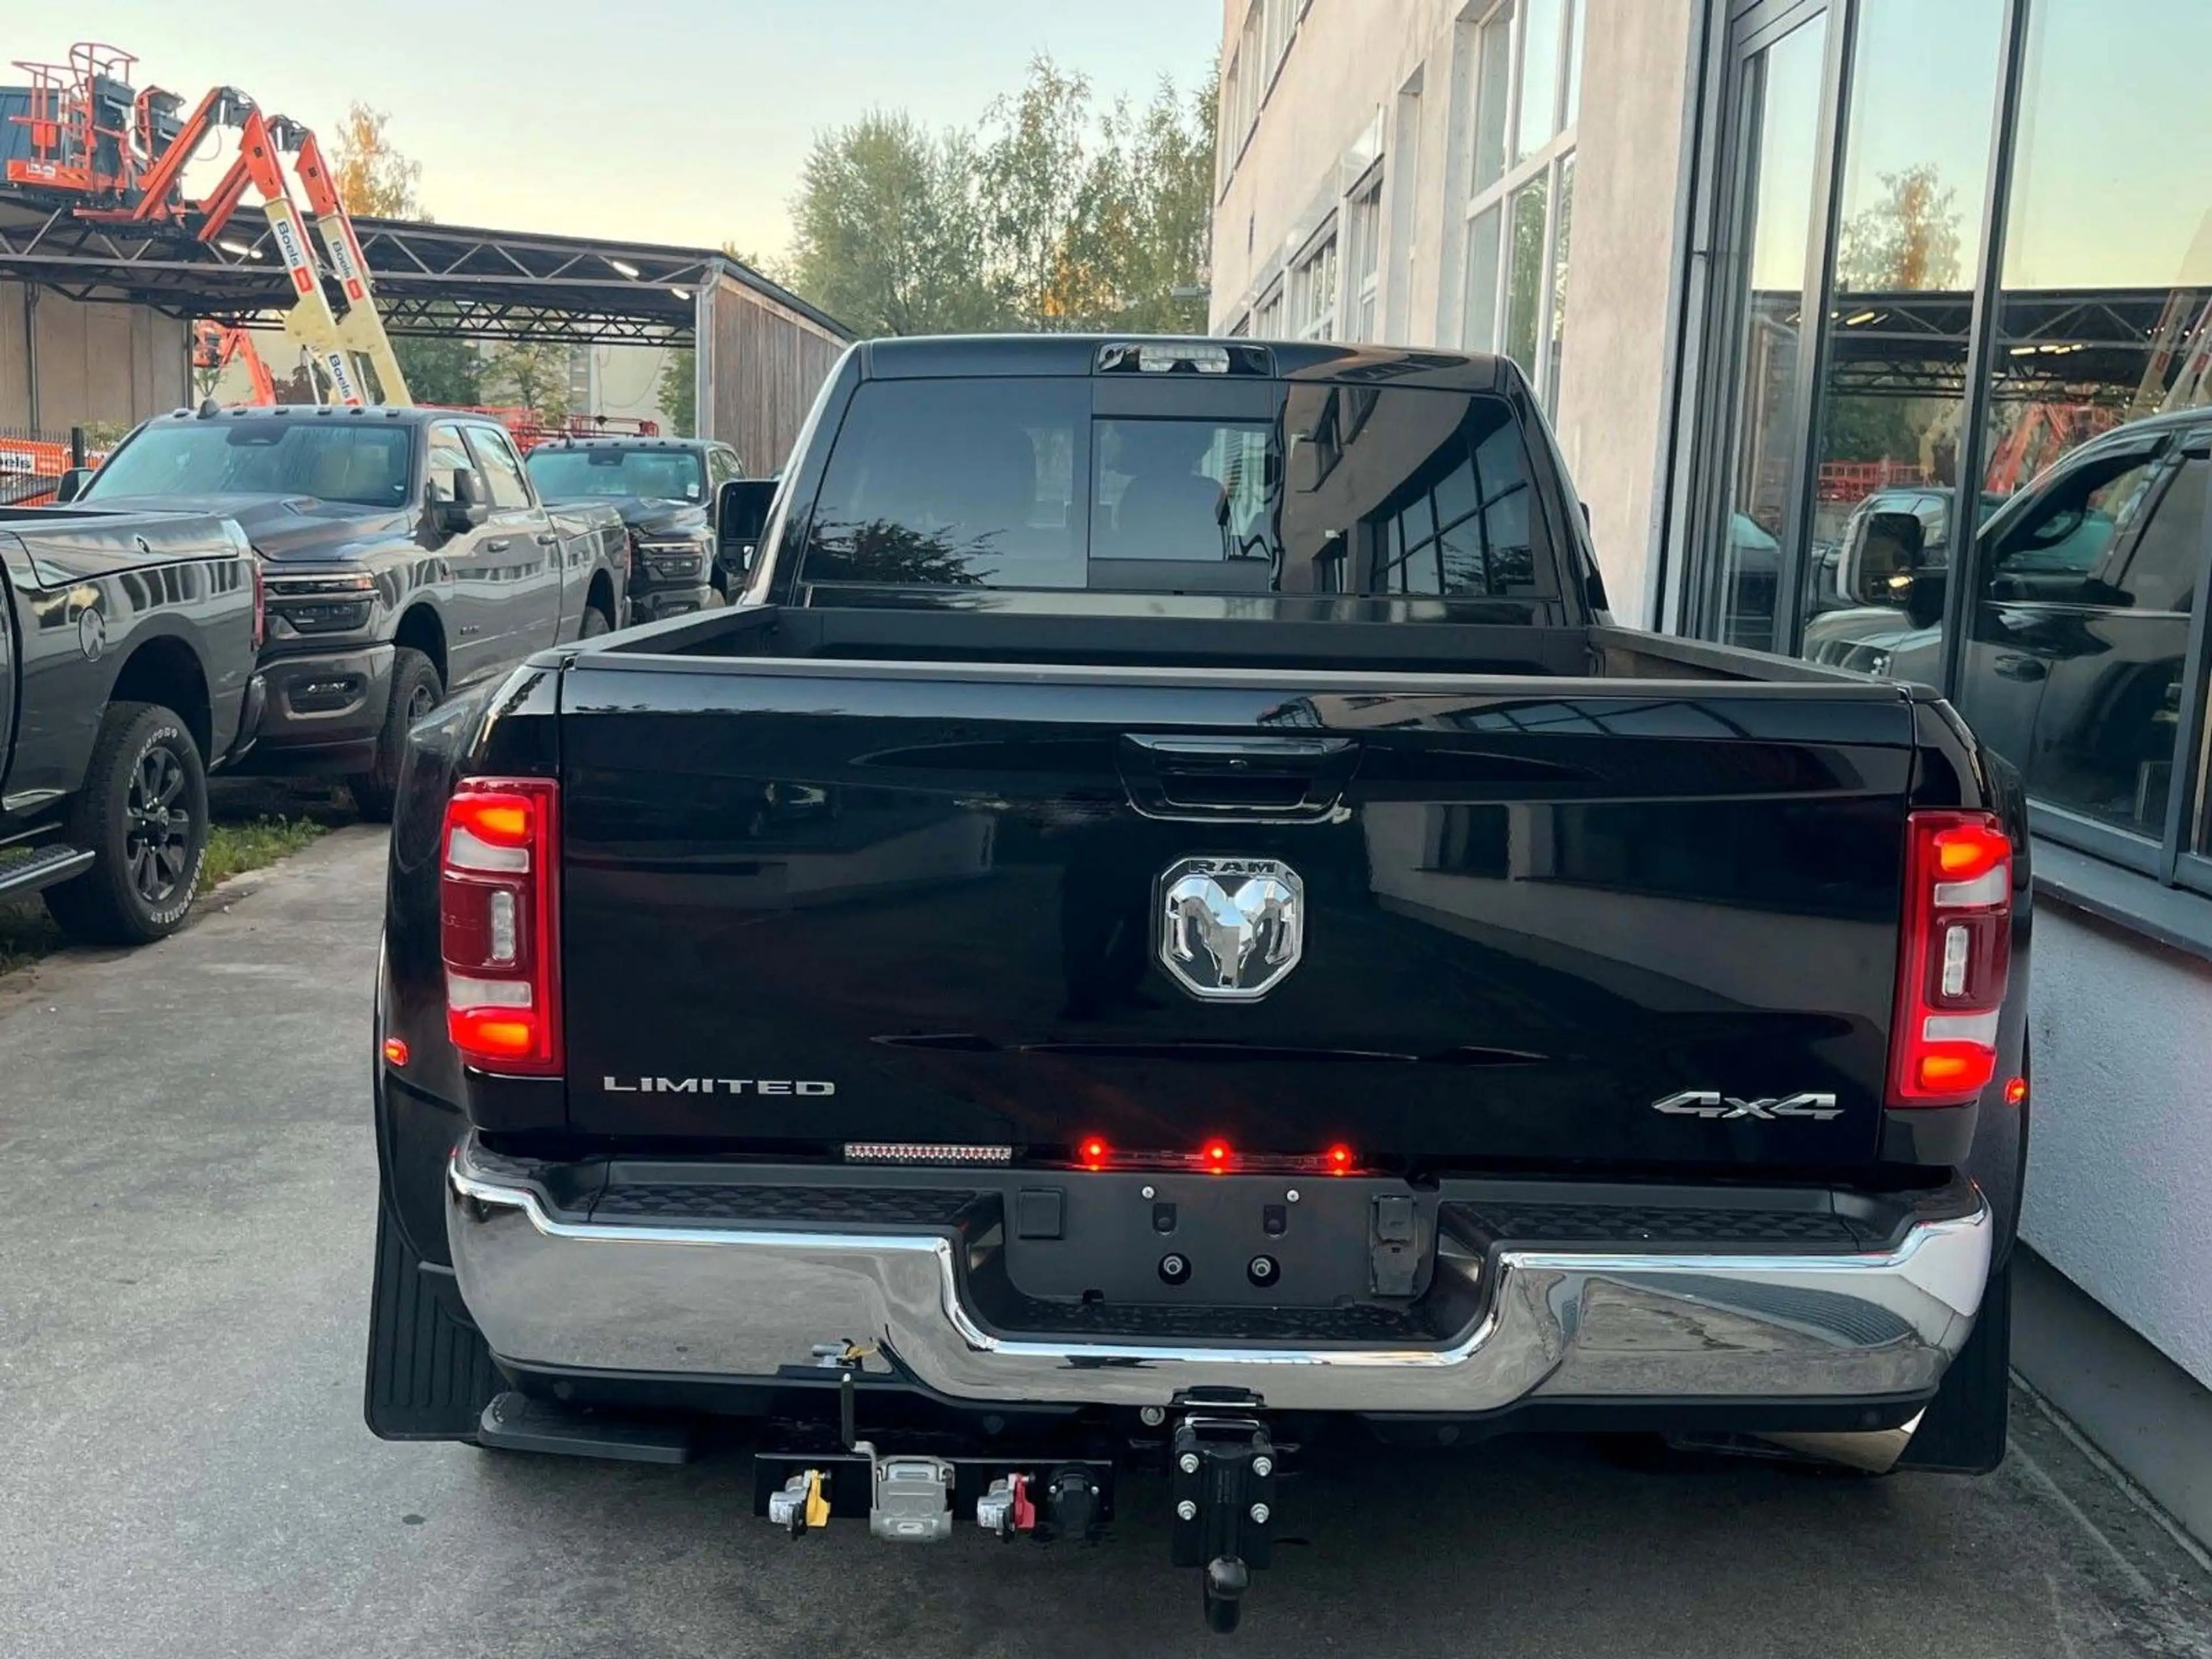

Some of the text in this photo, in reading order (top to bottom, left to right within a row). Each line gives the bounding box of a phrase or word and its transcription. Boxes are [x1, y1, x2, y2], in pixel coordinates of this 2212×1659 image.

[276, 221, 298, 266] Boels
[331, 241, 352, 278] Boels
[329, 354, 351, 399] Boels
[1190, 859, 1275, 873] RAM
[604, 1076, 835, 1096] LIMITED
[1652, 1091, 1845, 1120] 4x4
